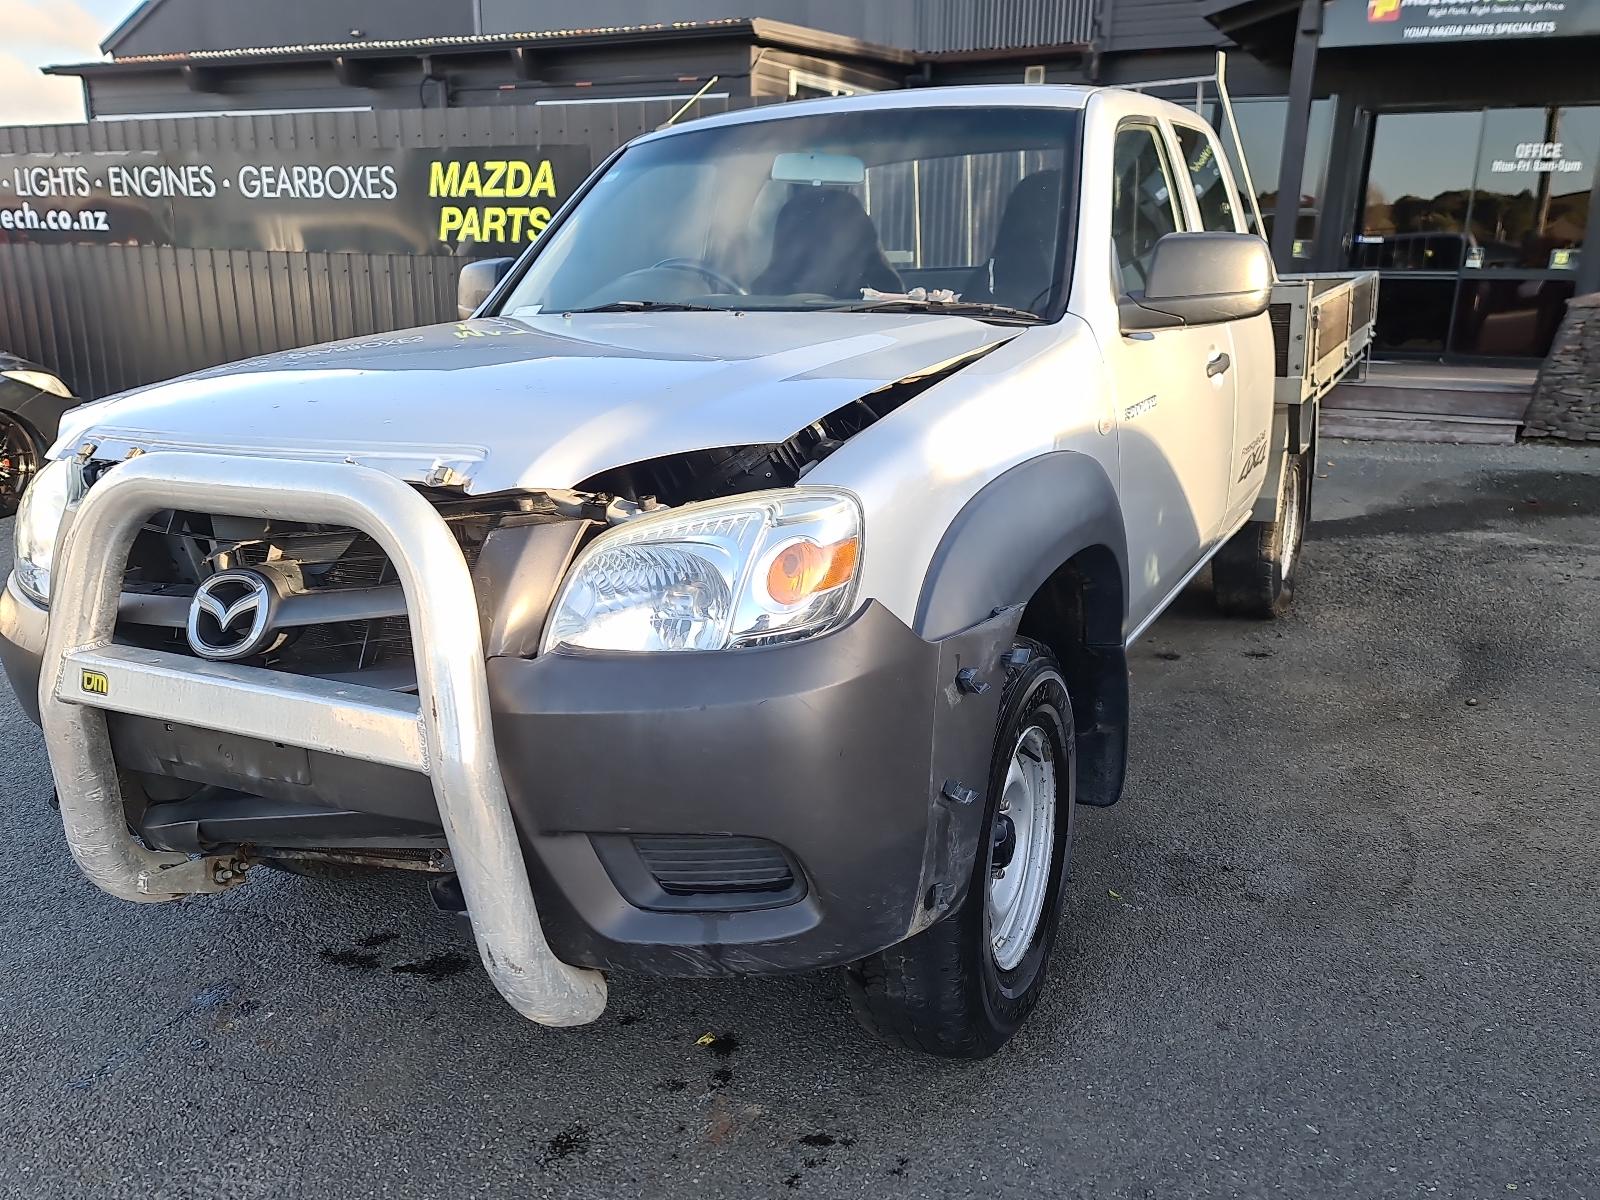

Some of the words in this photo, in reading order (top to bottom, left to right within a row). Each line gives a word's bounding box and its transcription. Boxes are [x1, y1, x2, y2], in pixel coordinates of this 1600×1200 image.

[1429, 25, 1463, 37] MAZDA
[1463, 24, 1495, 36] PARTS
[1515, 142, 1563, 159] OFFICE
[14, 166, 91, 197] LIGHTS
[108, 165, 217, 197] ENGINES
[238, 164, 398, 200] GEARBOXES
[428, 160, 557, 198] MAZDA
[0, 201, 110, 231] ech.co.nz
[438, 206, 552, 243] PARTS
